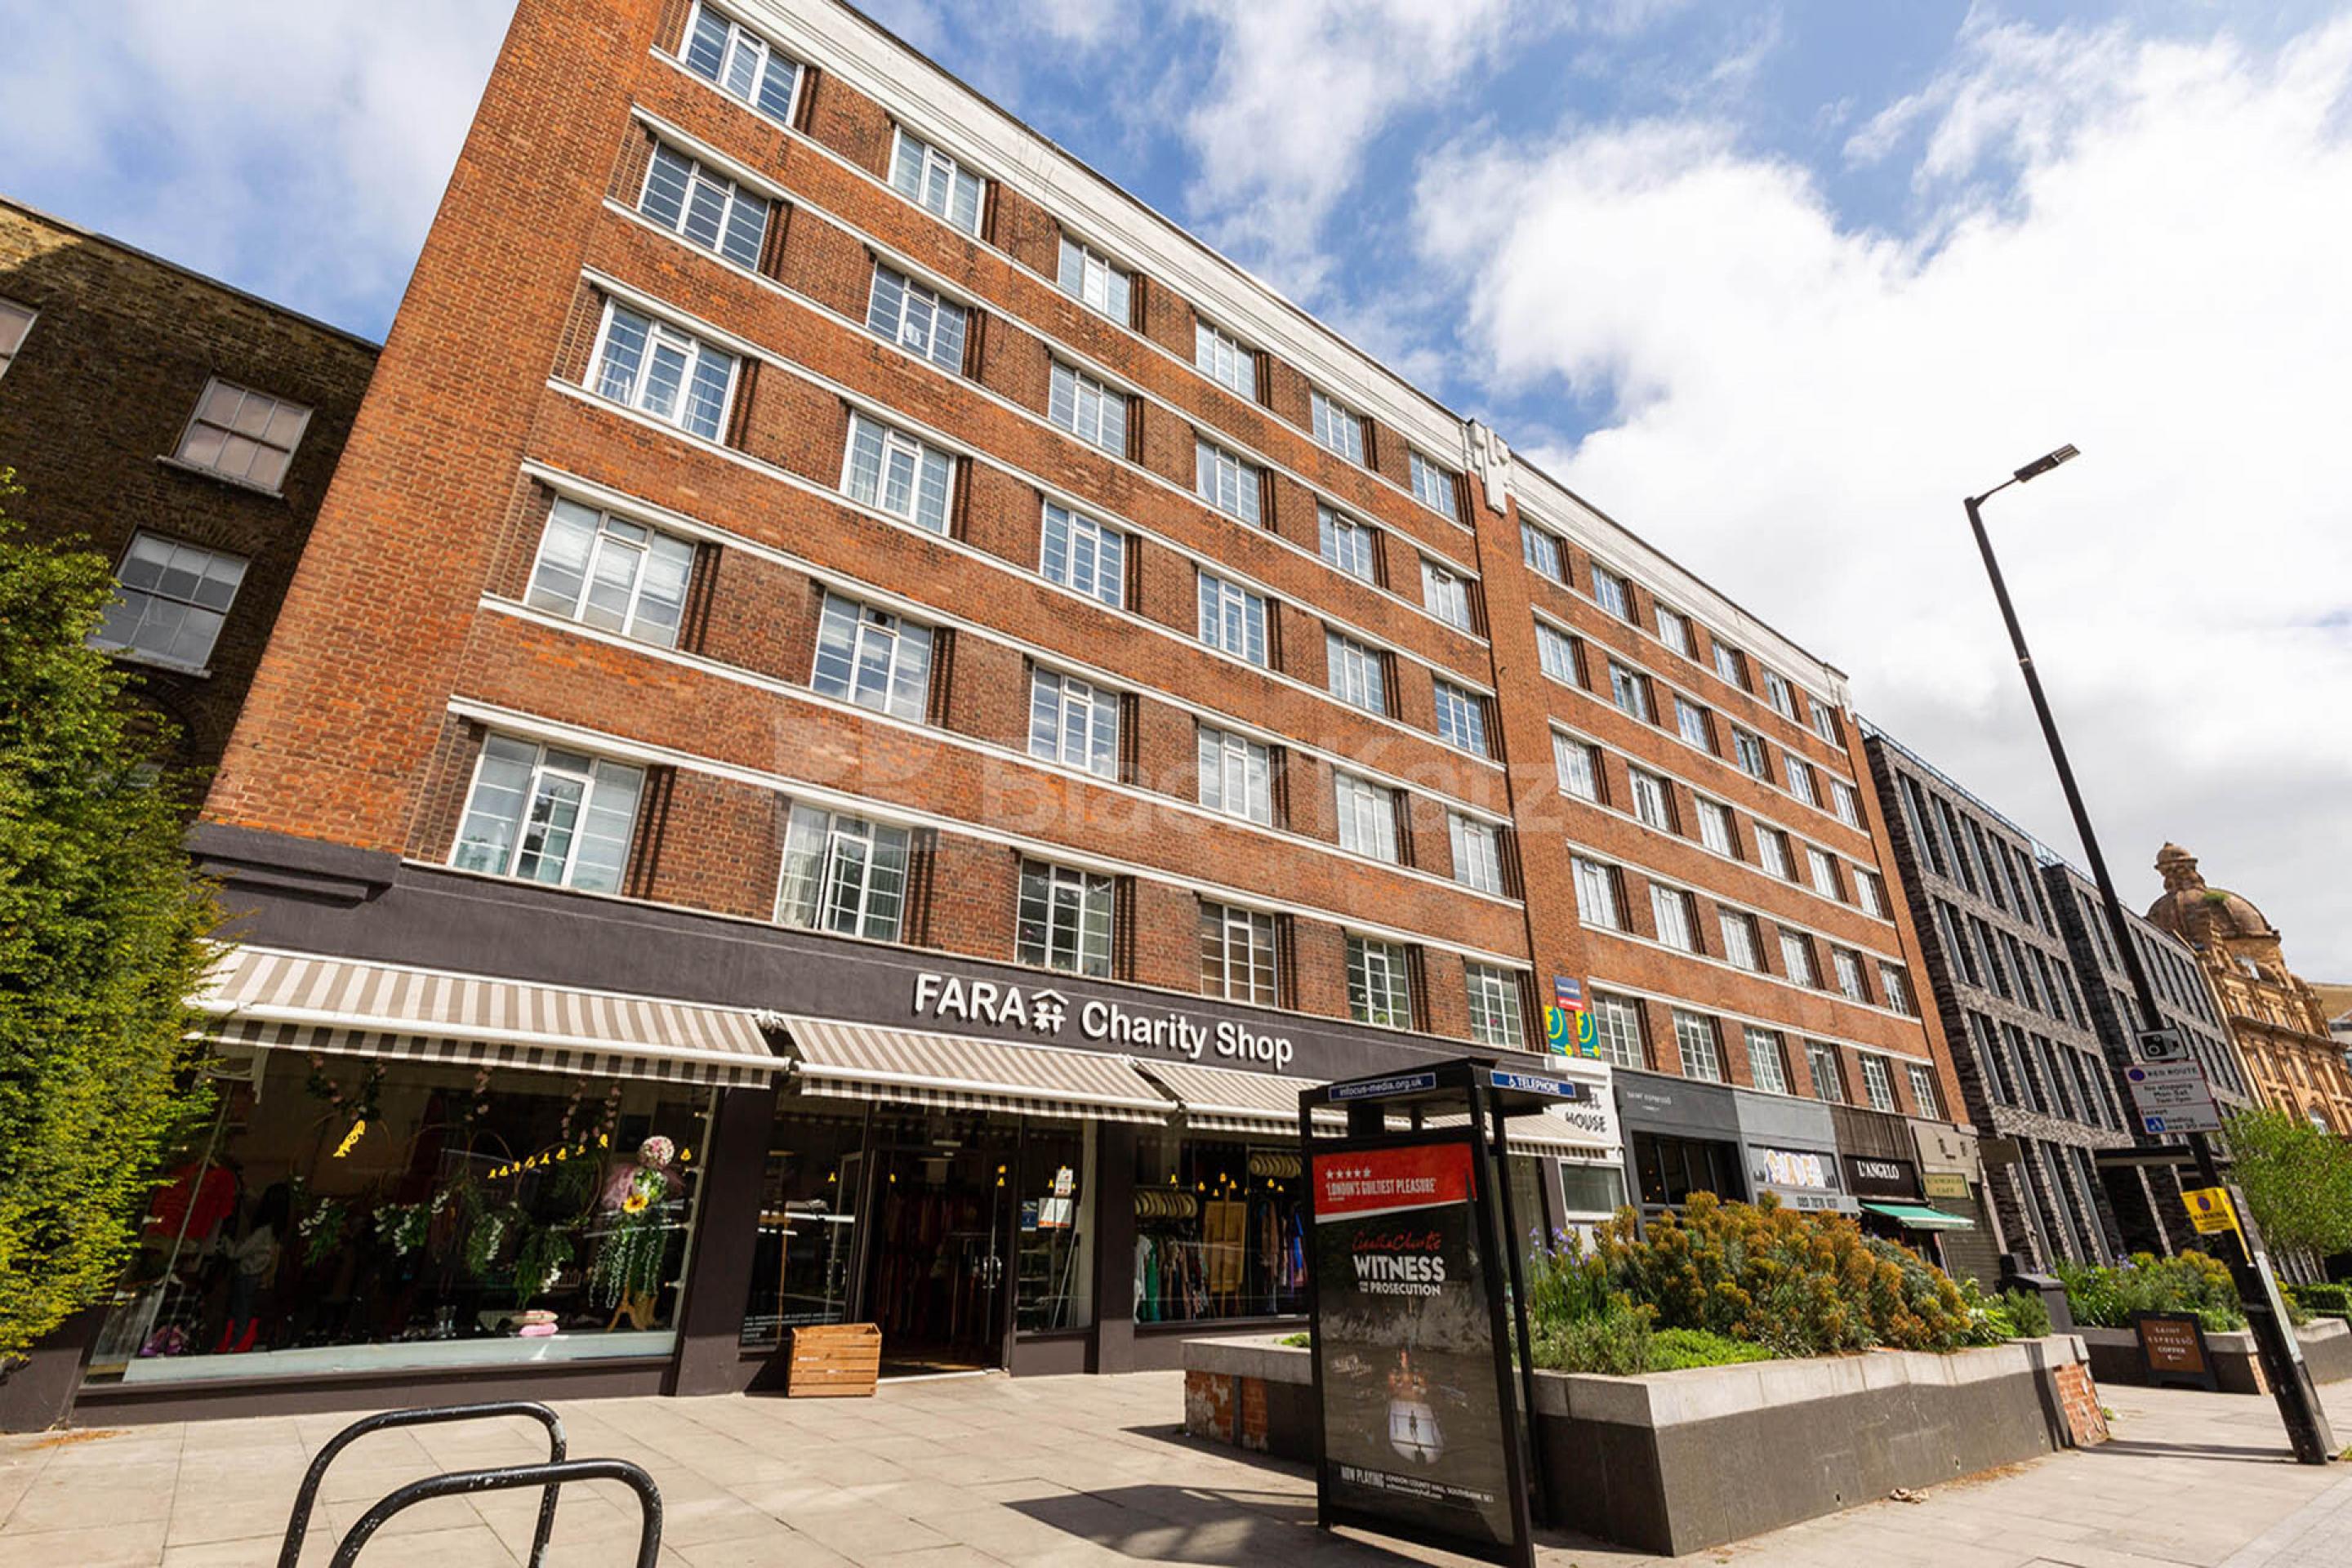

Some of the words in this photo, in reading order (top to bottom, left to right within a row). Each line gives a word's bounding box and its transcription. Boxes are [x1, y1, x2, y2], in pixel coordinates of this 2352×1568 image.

[914, 972, 1027, 1027] FARA
[1081, 1000, 1209, 1059] Charity
[1214, 1021, 1294, 1071] Shop
[1517, 1076, 1561, 1094] TELEPHONE
[1565, 1111, 1608, 1133] HOUSE
[1352, 1254, 1446, 1283] WITNESS
[1370, 1281, 1441, 1297] PROSECUTION
